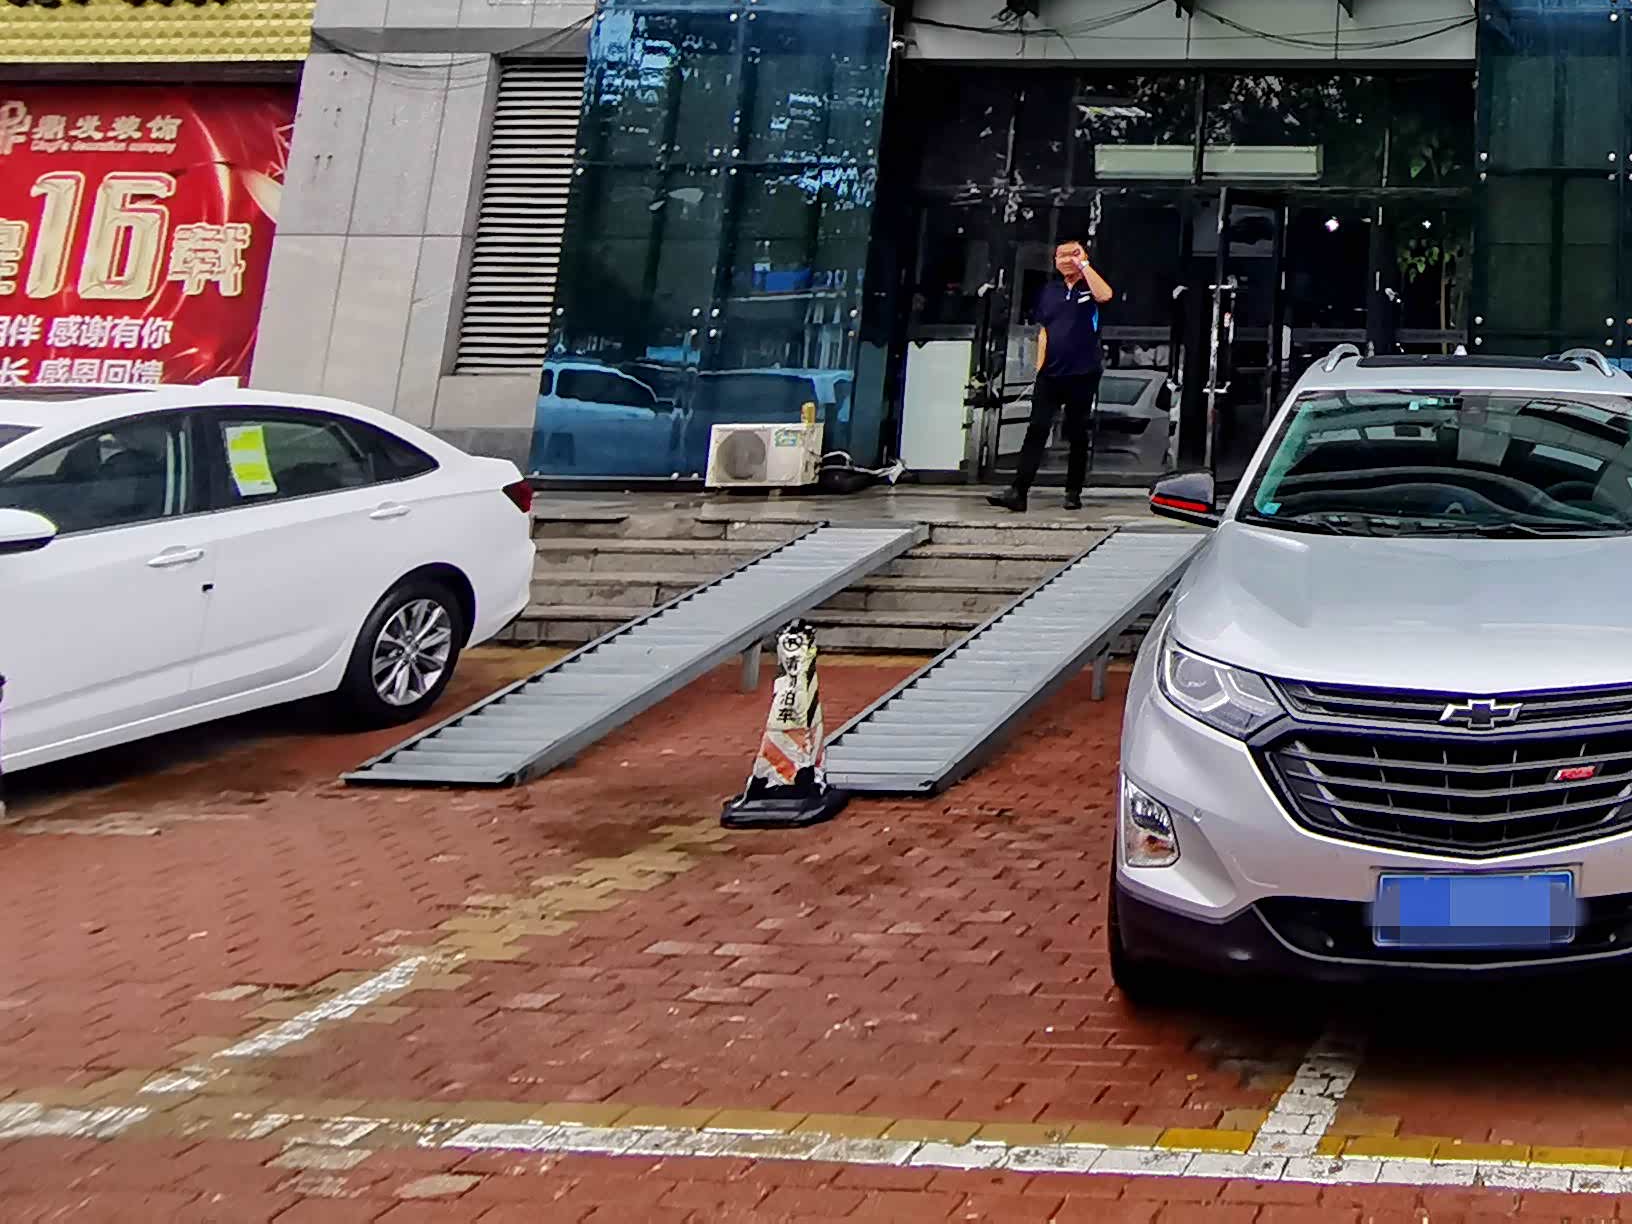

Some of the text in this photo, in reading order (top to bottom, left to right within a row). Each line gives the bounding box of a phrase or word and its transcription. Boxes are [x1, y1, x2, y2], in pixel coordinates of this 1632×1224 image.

[0, 314, 173, 349] 伴 感谢有你
[35, 358, 163, 384] 感恩回馈
